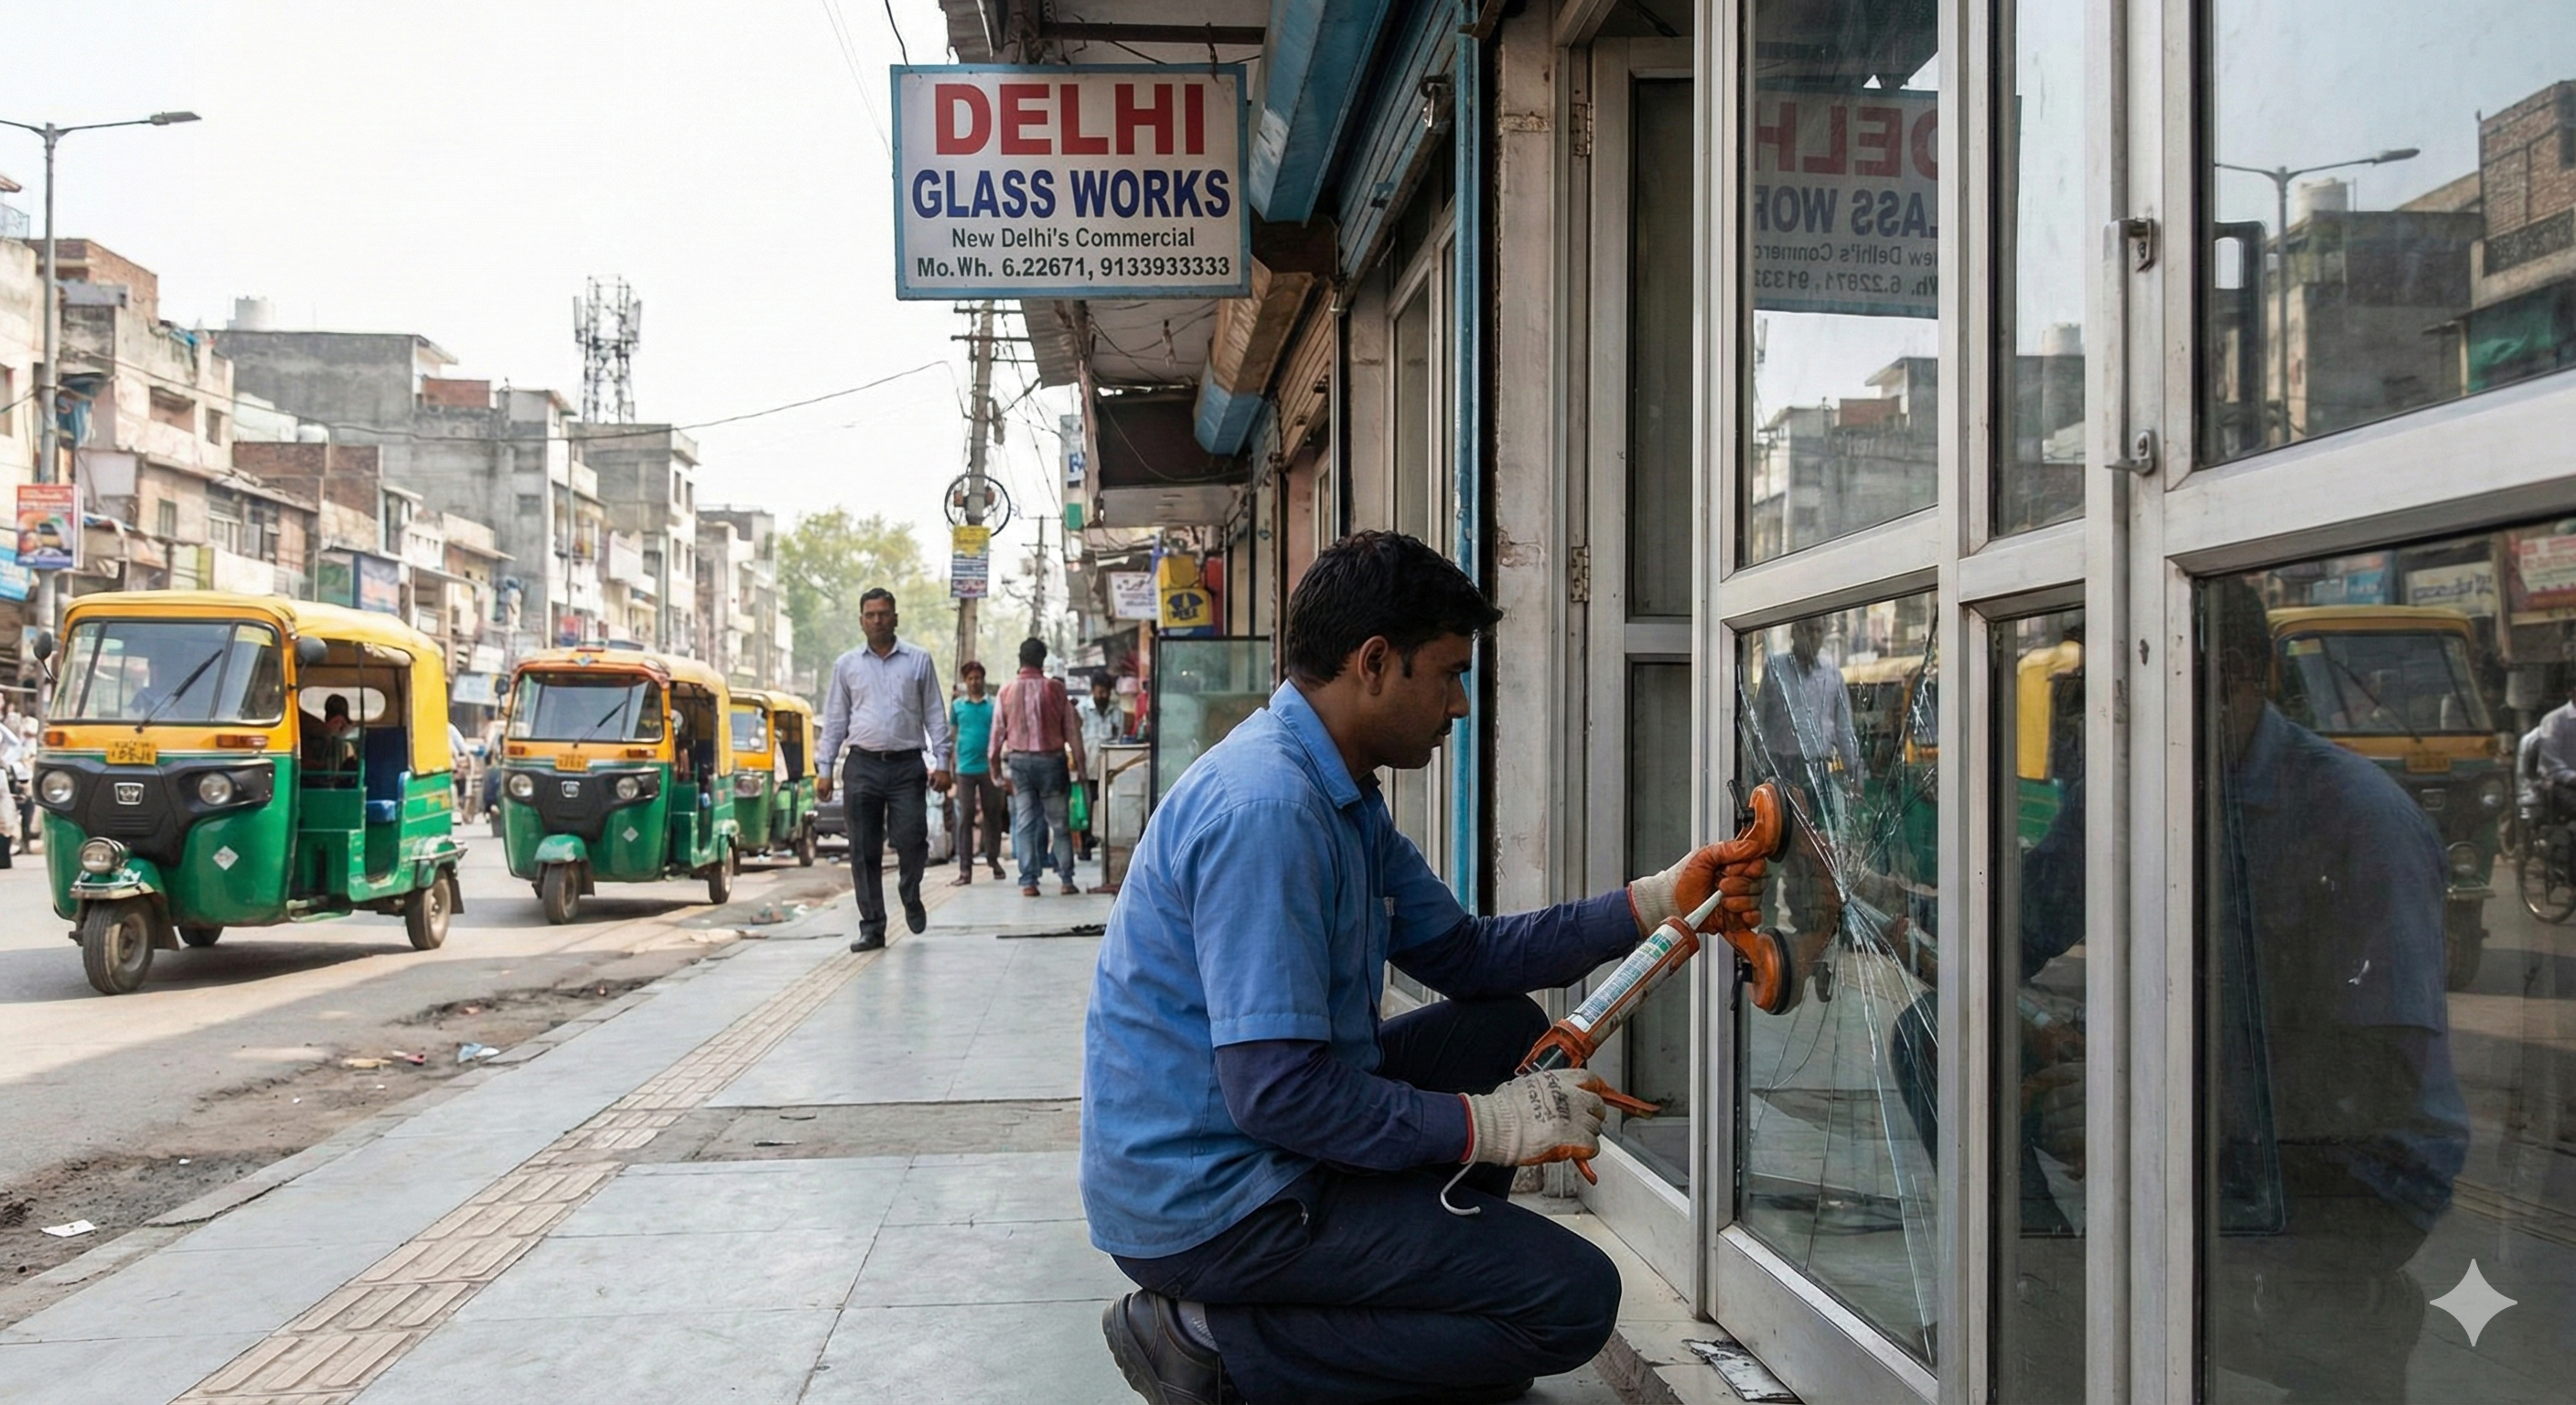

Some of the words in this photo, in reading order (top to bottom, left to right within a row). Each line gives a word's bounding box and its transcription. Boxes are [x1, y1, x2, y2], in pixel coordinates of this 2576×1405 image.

[935, 83, 1205, 156] DELHI
[912, 169, 1057, 219] GLASS
[1069, 169, 1230, 219] WORKS
[951, 228, 995, 248] New
[1002, 227, 1068, 248] Delhi's
[1075, 227, 1195, 248] Commercial
[917, 257, 993, 277] Mo.Wh.
[1002, 257, 1094, 281] 6.22671,
[1100, 256, 1230, 277] 9133933333
